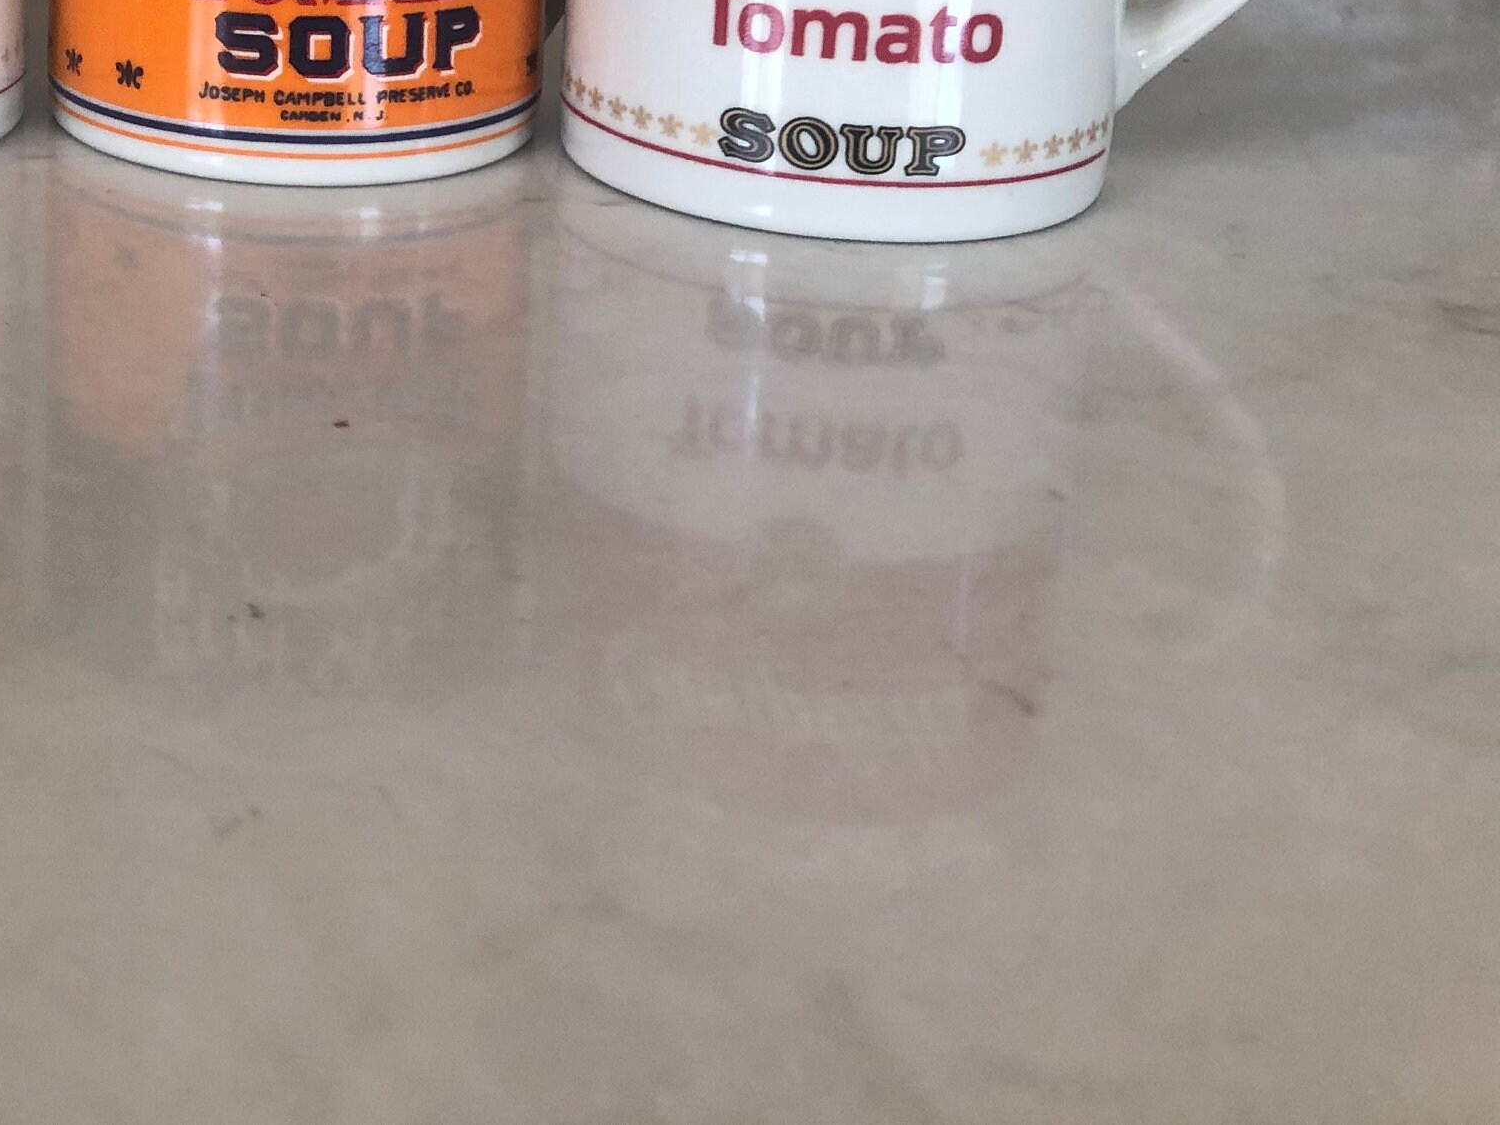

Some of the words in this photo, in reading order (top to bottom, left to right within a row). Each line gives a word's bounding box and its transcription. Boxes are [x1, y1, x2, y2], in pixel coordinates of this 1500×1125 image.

[213, 4, 485, 84] SOUP
[199, 81, 266, 104] JOSEPH
[273, 89, 367, 108] CAMPBELL
[376, 82, 451, 105] PRESERVE
[455, 80, 476, 98] CO.
[716, 106, 966, 177] SOUP
